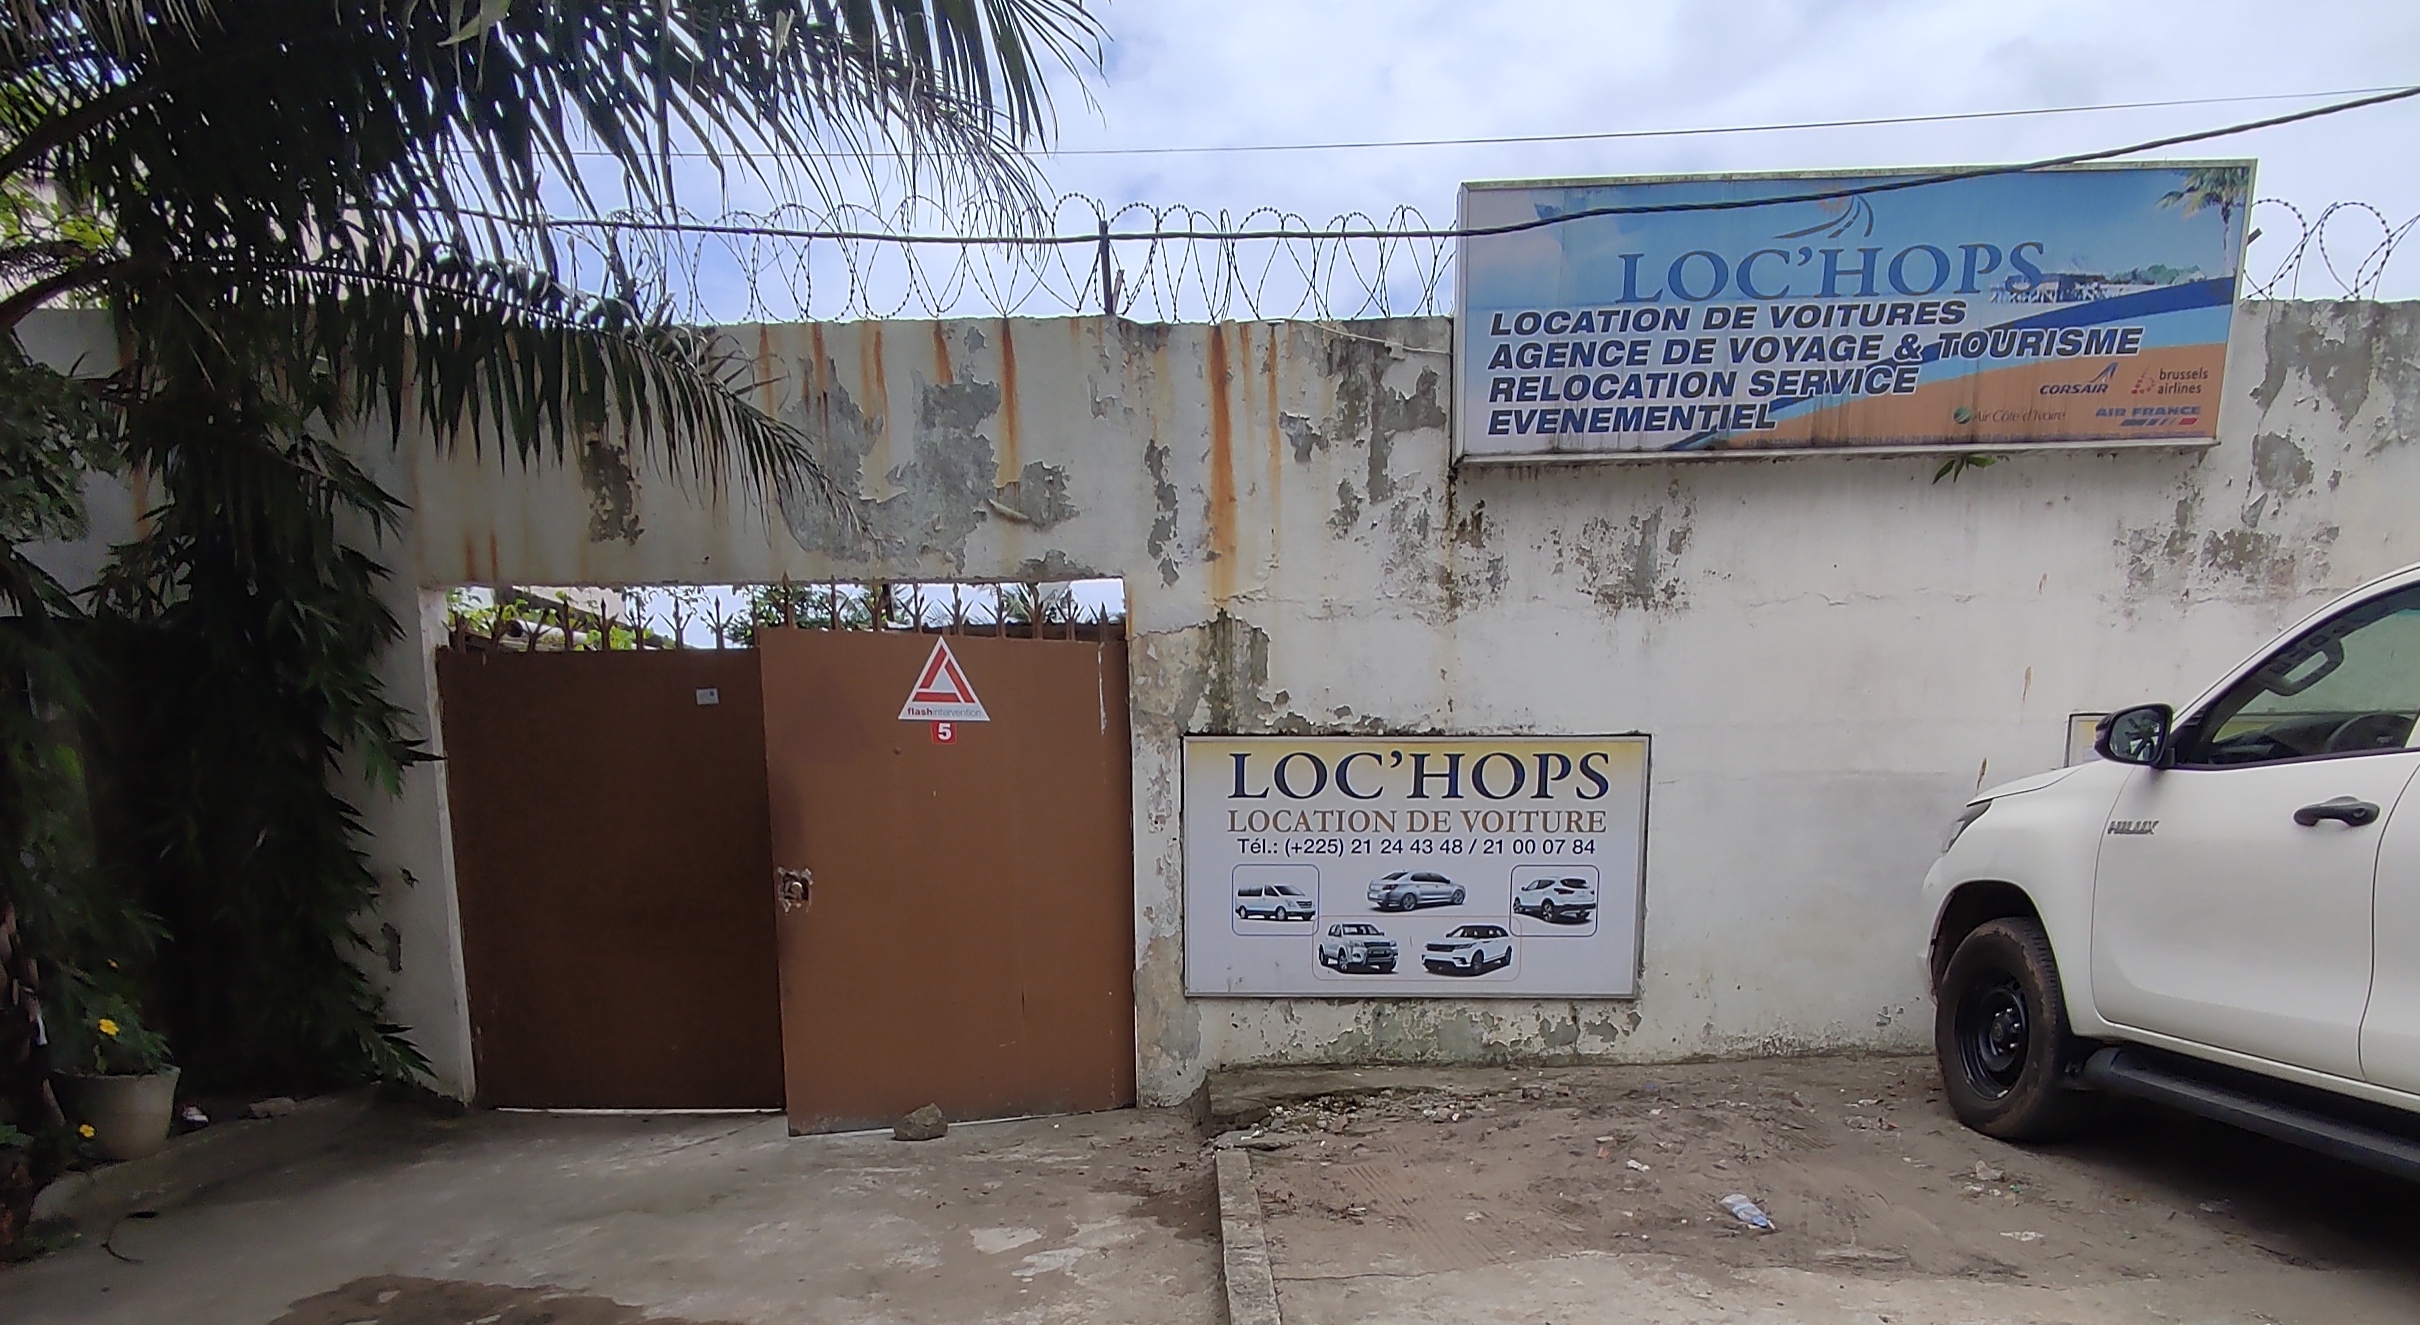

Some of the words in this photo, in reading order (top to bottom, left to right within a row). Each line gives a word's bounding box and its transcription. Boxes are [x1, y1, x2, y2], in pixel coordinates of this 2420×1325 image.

[1490, 307, 1691, 336] LOCATION
[1702, 306, 1758, 330] DE
[1770, 300, 1967, 329] VOITURES
[1487, 339, 1652, 370] AGENCE
[1661, 338, 1717, 366] DE
[1729, 334, 1884, 364] VOYAGE
[1893, 332, 1922, 362] &
[1937, 327, 2144, 359] TOURISME
[2159, 367, 2209, 381] brussels
[1489, 370, 1738, 402] RELOCATION
[1748, 366, 1920, 397] SERVICE
[2039, 383, 2110, 395] CORSAIR
[2157, 383, 2202, 395] airlines
[1487, 403, 1777, 435] EVENEMENTIEL
[2095, 407, 2127, 417] AIR
[2131, 405, 2202, 416] FRANCE
[937, 722, 952, 740] 5
[1227, 809, 1397, 833] LOCATION
[1406, 809, 1452, 833] DE
[1460, 809, 1607, 833] VOITURE
[2107, 820, 2160, 835] HILUX
[1237, 838, 1278, 854] Tél.:
[1285, 838, 1344, 857] (+225)
[1350, 838, 1372, 854] 21
[1380, 838, 1403, 854] 24
[1409, 838, 1433, 854] 43
[1439, 838, 1463, 854] 48
[1468, 838, 1477, 855] /
[1483, 838, 1503, 854] 21
[1512, 838, 1536, 855] 00
[1542, 838, 1566, 855] 07
[1572, 838, 1595, 854] 84
